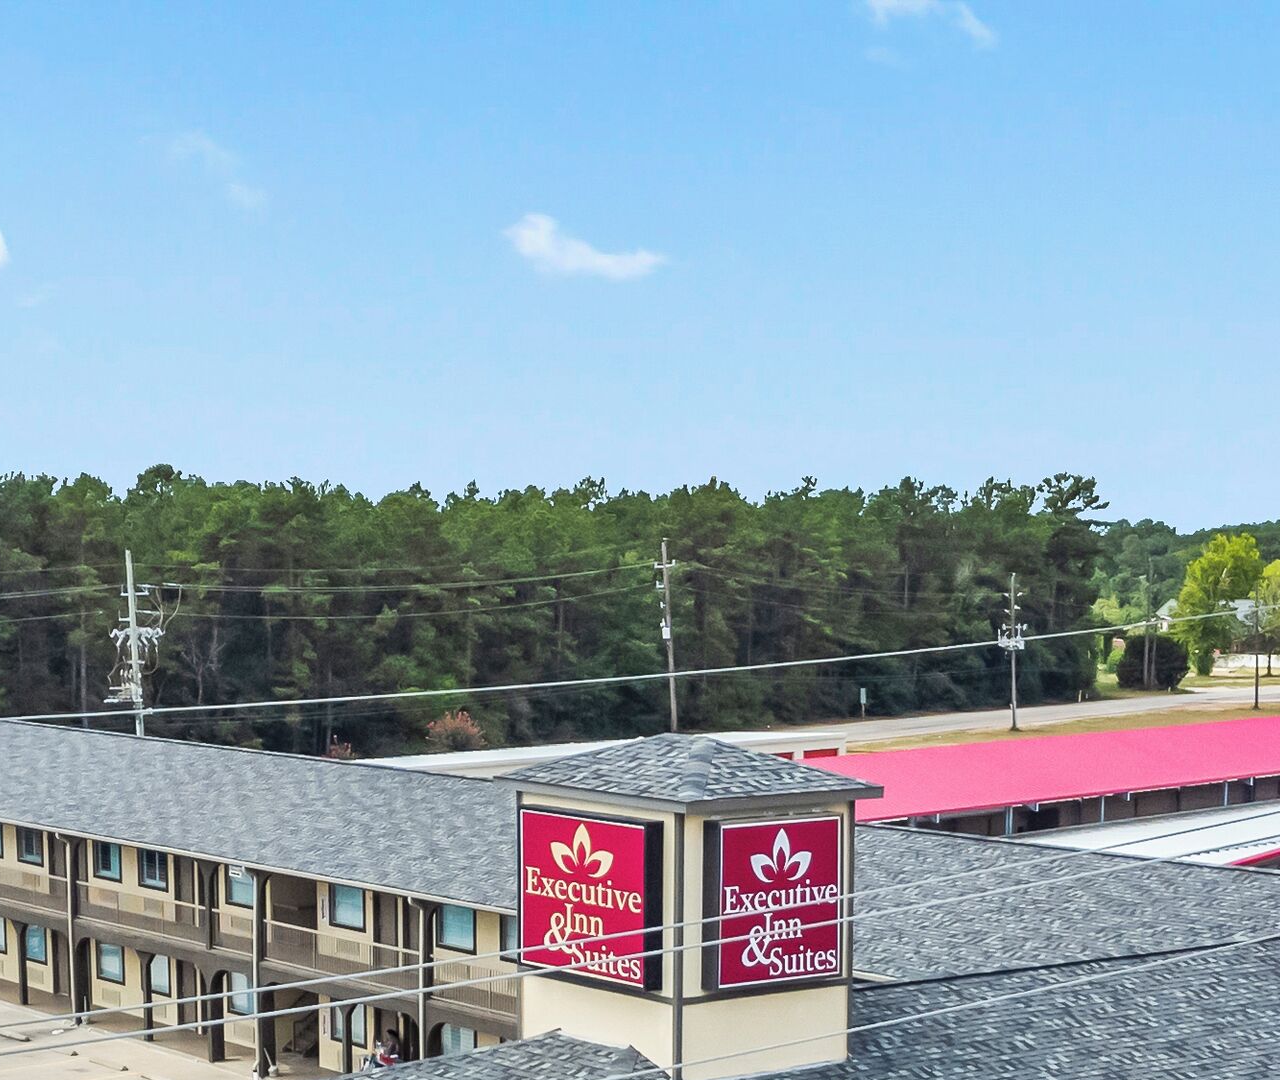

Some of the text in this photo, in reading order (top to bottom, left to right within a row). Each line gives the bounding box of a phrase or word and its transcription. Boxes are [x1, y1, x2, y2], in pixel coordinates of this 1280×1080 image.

[525, 865, 642, 914] Executive
[723, 878, 838, 915] Executive
[564, 903, 605, 937] Inn
[763, 912, 803, 941] Inn
[543, 912, 641, 980] & Suites
[741, 925, 837, 976] & Suites
